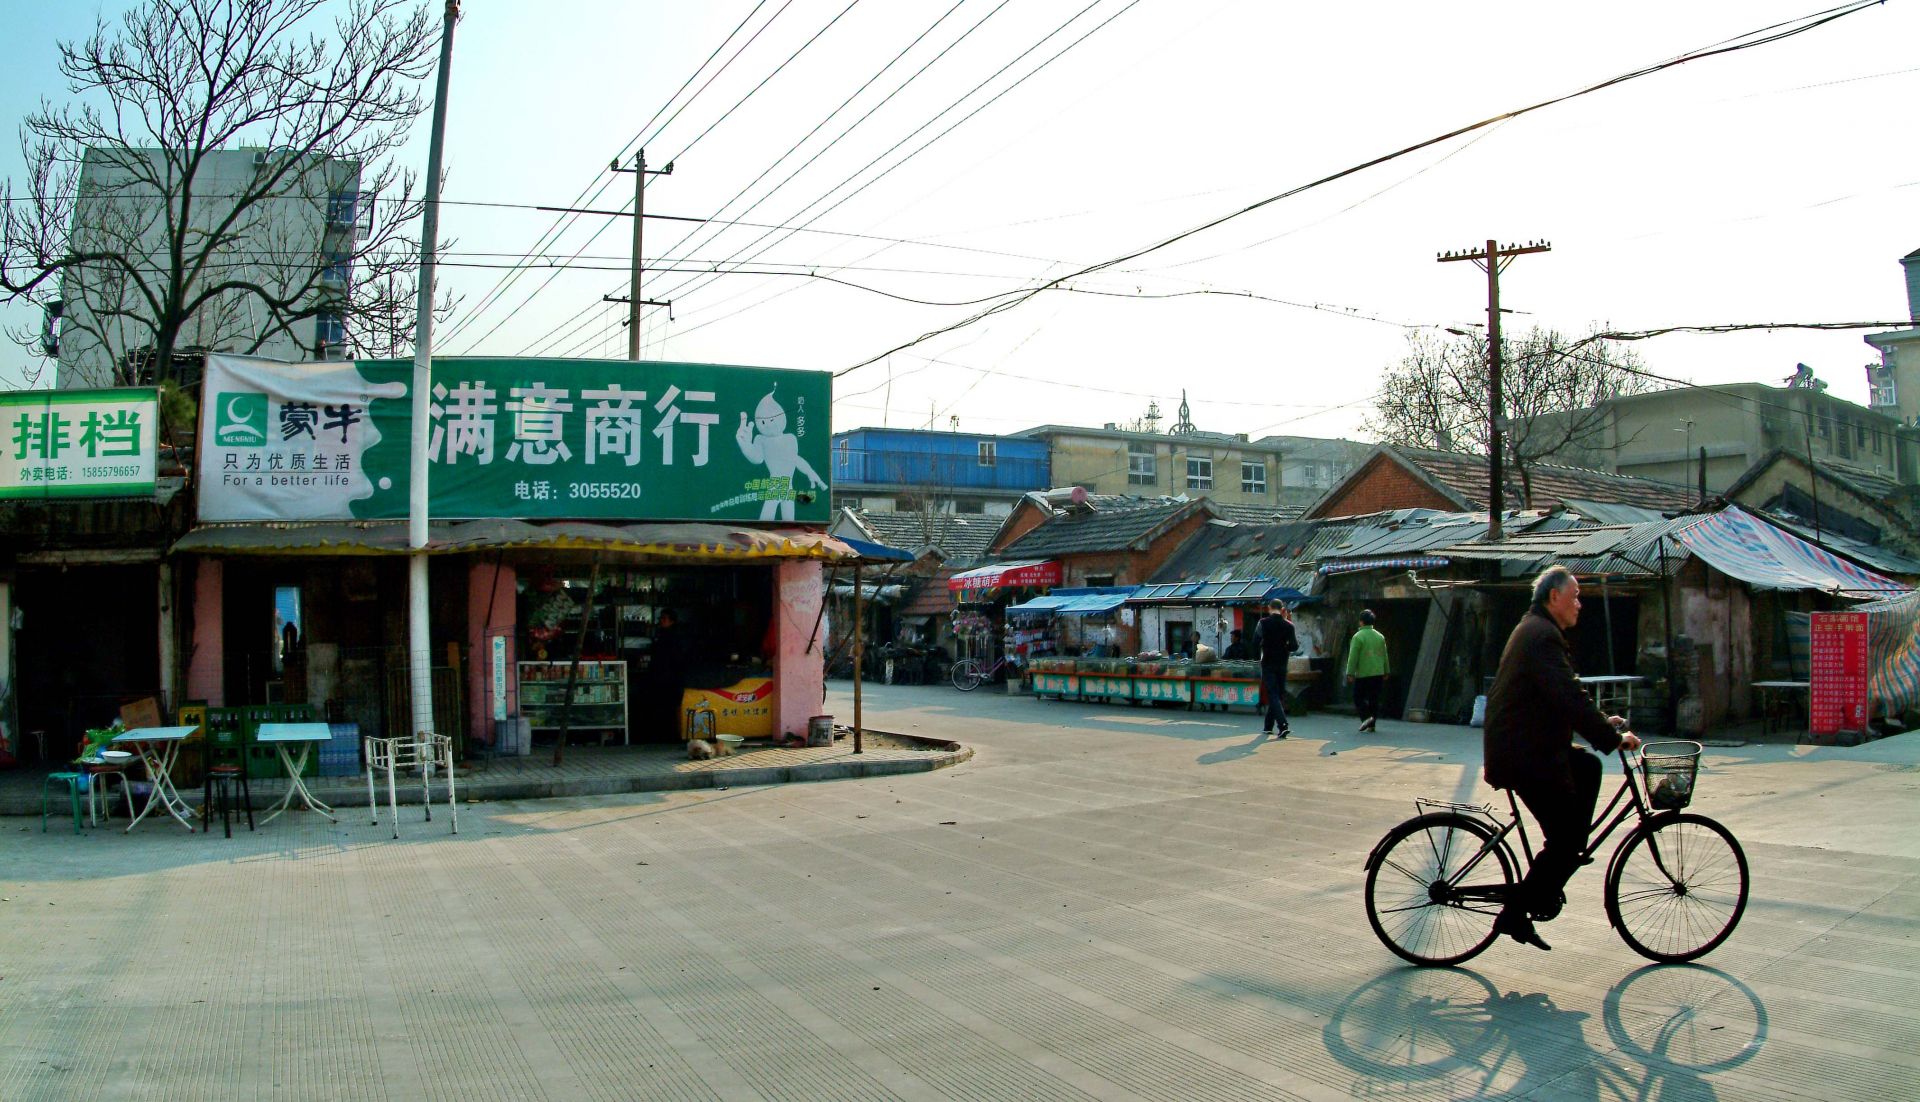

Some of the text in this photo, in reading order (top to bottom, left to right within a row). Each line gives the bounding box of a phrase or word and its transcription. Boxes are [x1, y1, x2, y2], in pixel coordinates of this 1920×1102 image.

[279, 401, 362, 444] 蒙牛
[428, 381, 719, 467] 满意商行
[0, 410, 141, 460] 排档
[223, 435, 257, 443] MENGNIU
[223, 453, 350, 470] 只为优质生活
[20, 465, 141, 481] 外卖电话： 15855796657
[223, 475, 349, 486] For a better life
[514, 480, 641, 500] 电话： 3055520
[963, 576, 1000, 589] 冰糖葫芦
